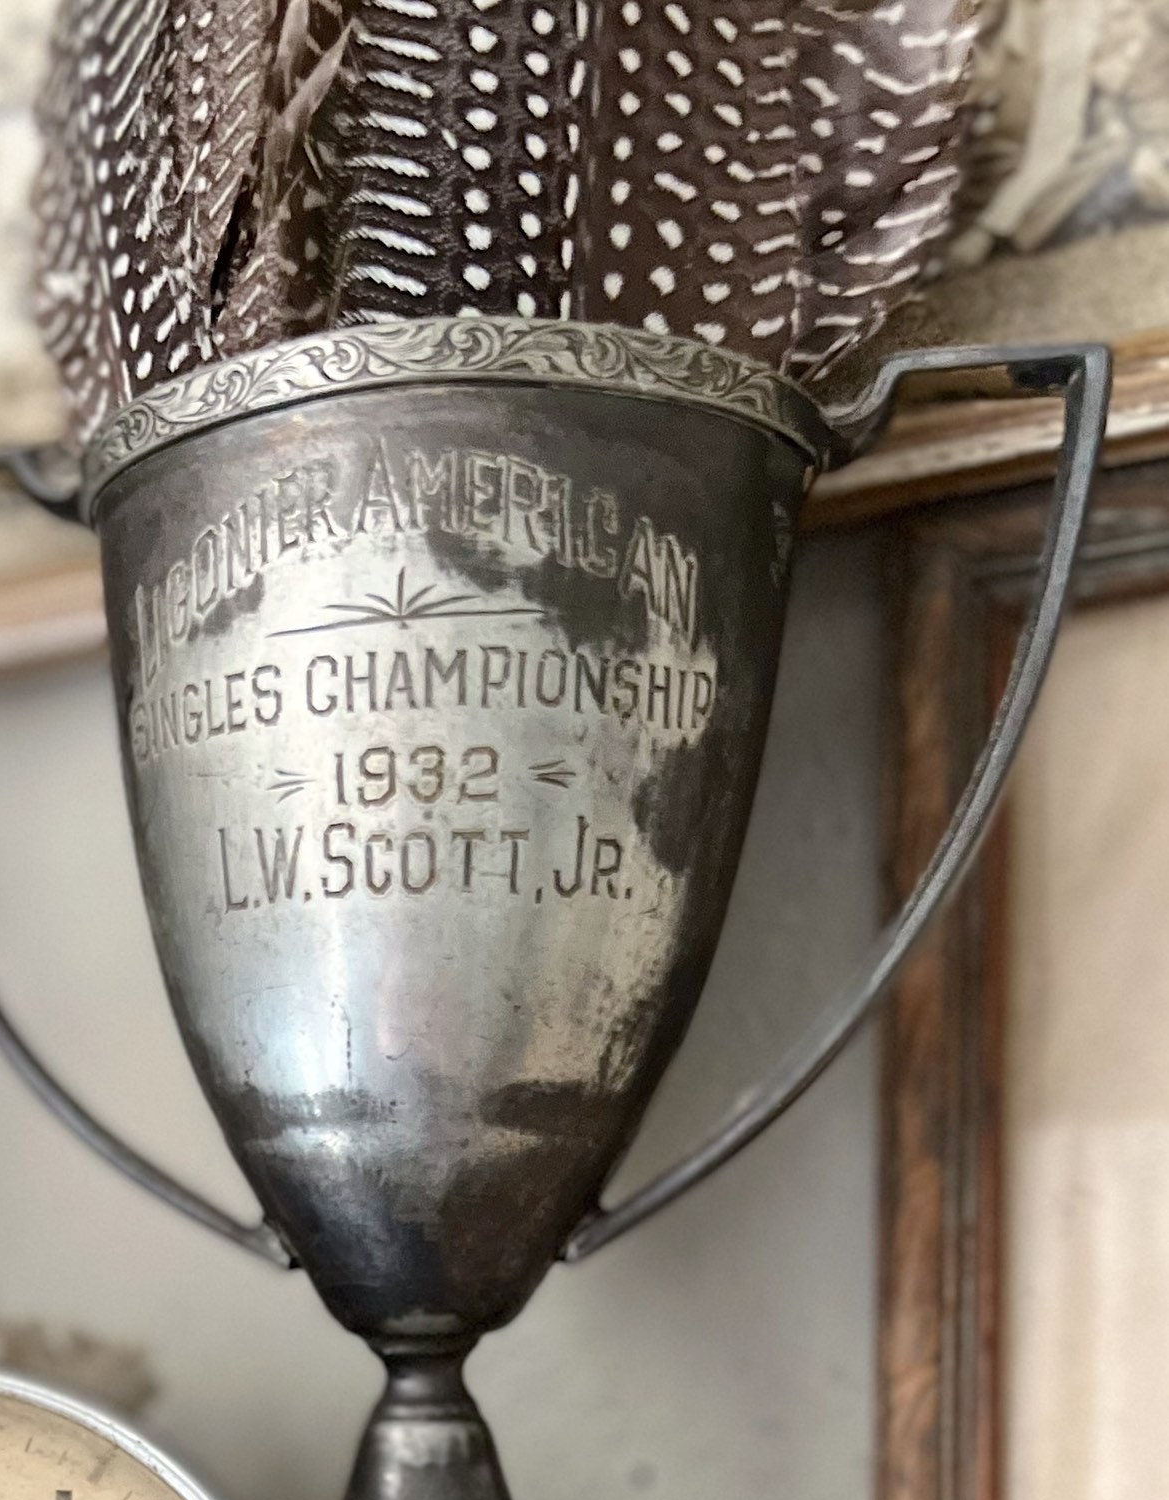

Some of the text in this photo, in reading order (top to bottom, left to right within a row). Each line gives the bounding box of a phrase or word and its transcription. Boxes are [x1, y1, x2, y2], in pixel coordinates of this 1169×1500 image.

[134, 461, 344, 692] LIGONIER
[353, 437, 700, 650] AMERICAN
[129, 644, 713, 762] SINGLES CHAMPIONSHIP
[334, 746, 499, 806] 1932
